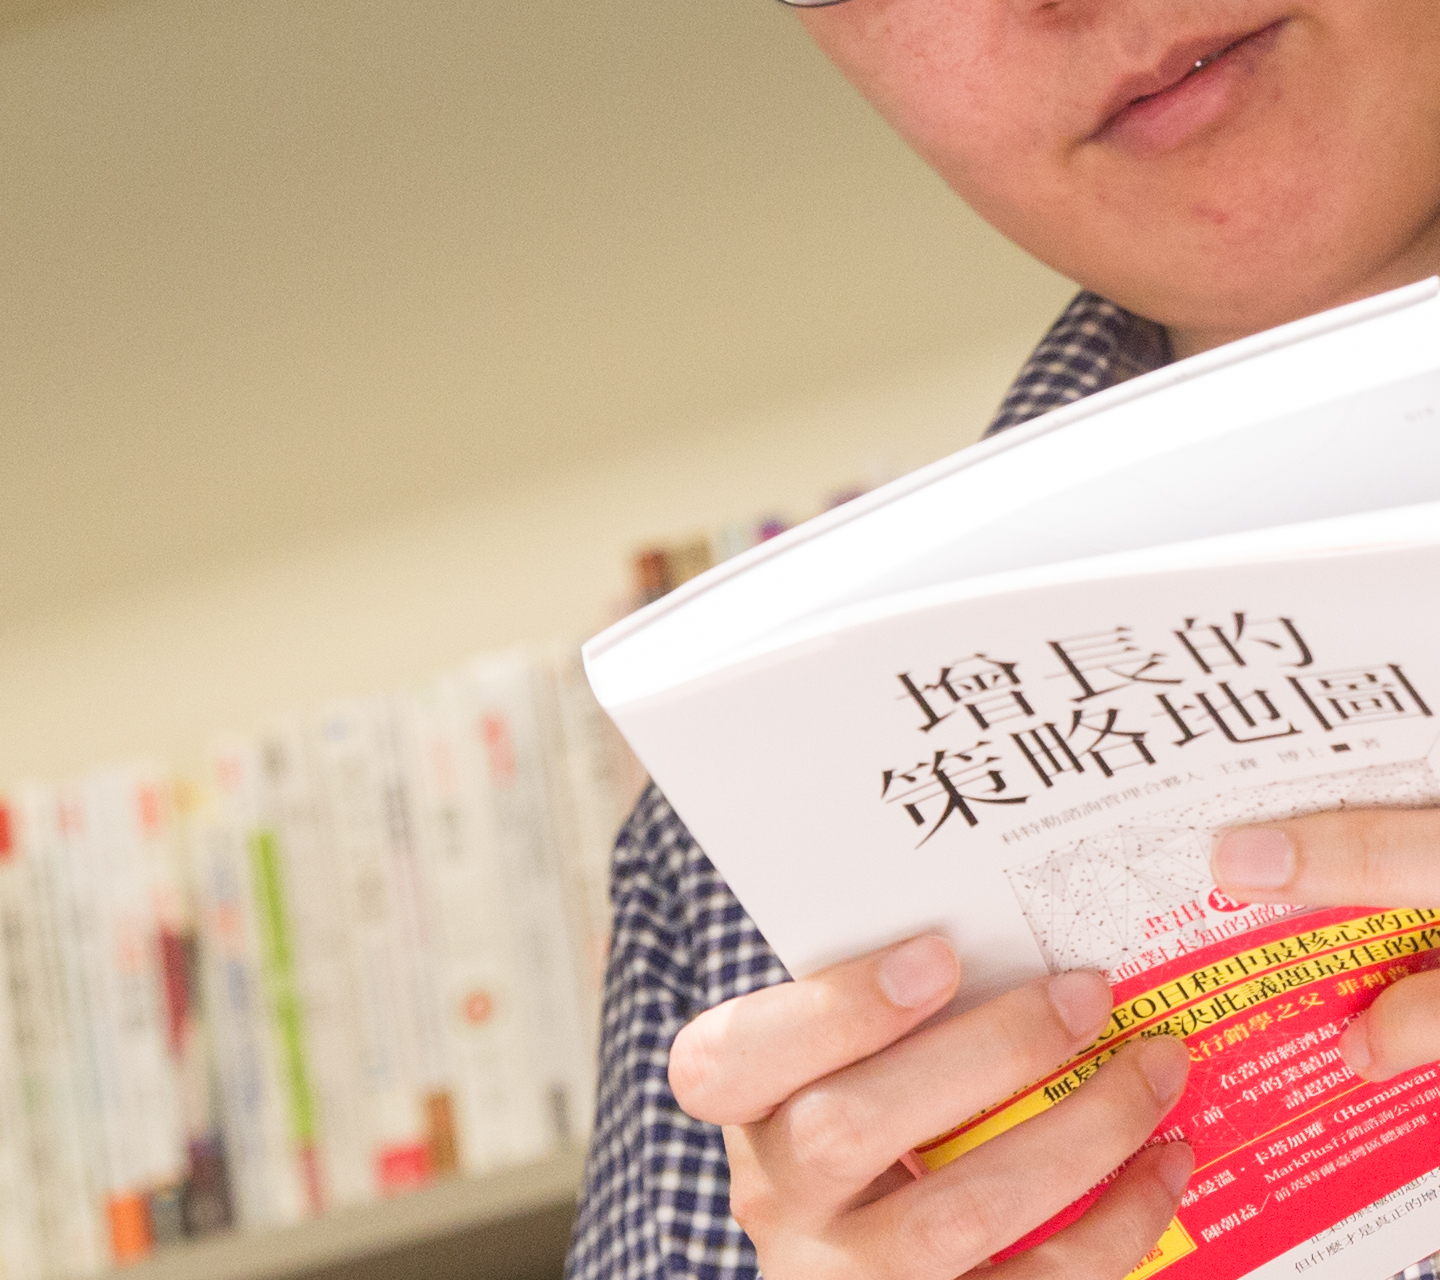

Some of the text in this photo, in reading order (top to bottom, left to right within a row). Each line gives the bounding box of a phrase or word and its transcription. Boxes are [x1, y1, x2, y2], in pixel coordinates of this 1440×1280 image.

[896, 612, 1315, 732] 增長的
[880, 662, 1435, 850] 策略地圖
